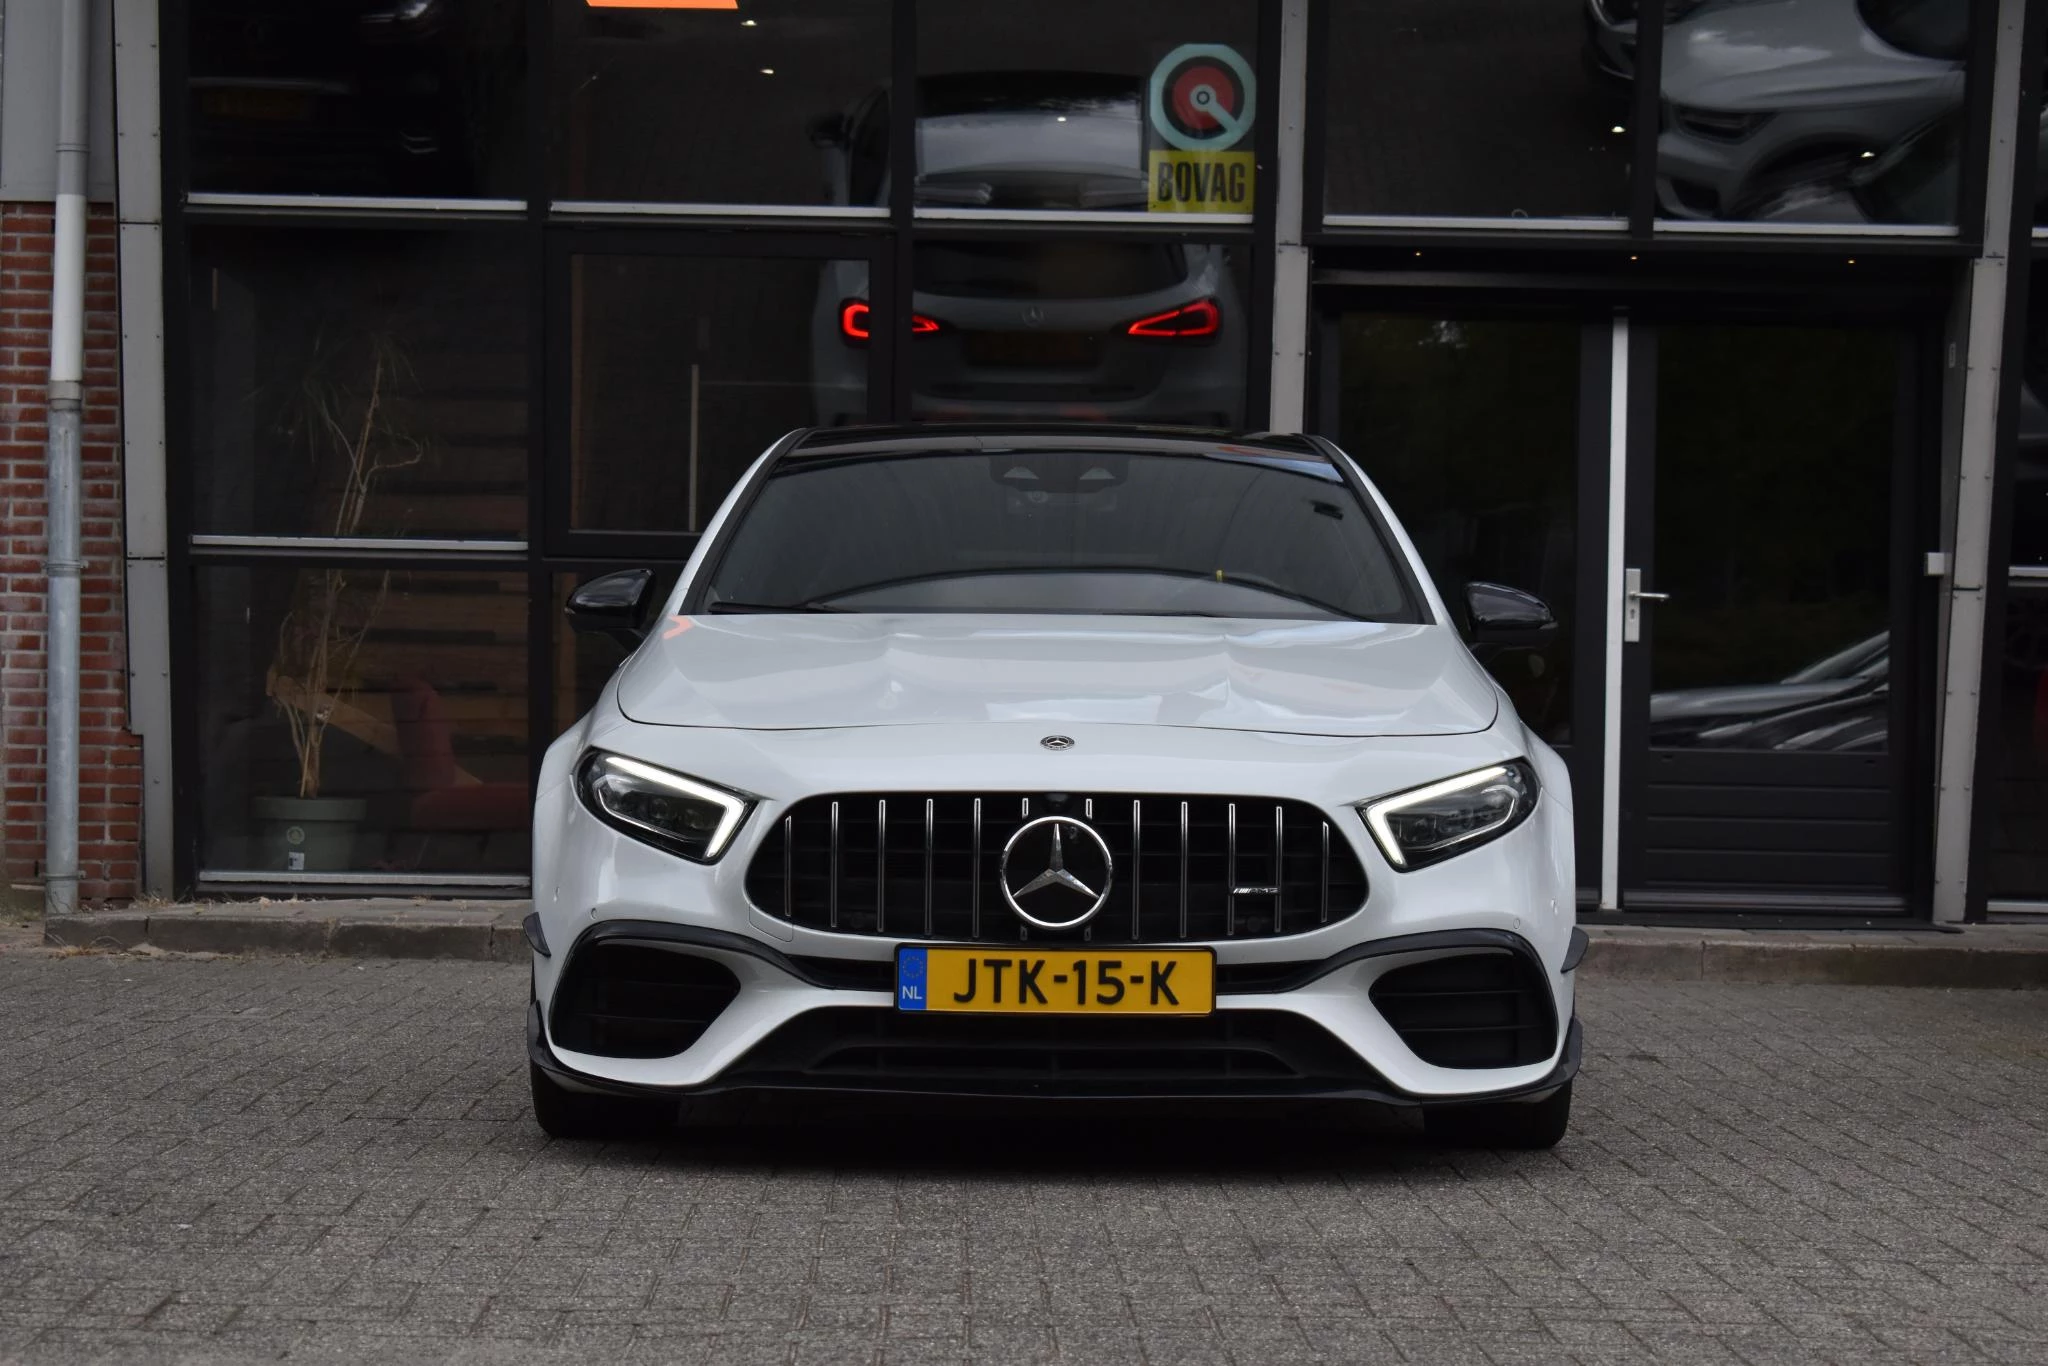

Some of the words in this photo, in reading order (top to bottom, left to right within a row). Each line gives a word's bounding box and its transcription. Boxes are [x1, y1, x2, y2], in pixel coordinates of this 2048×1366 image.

[1158, 162, 1246, 203] BOVAG
[902, 985, 923, 1000] NL
[953, 958, 1180, 1006] JTK-15-K
